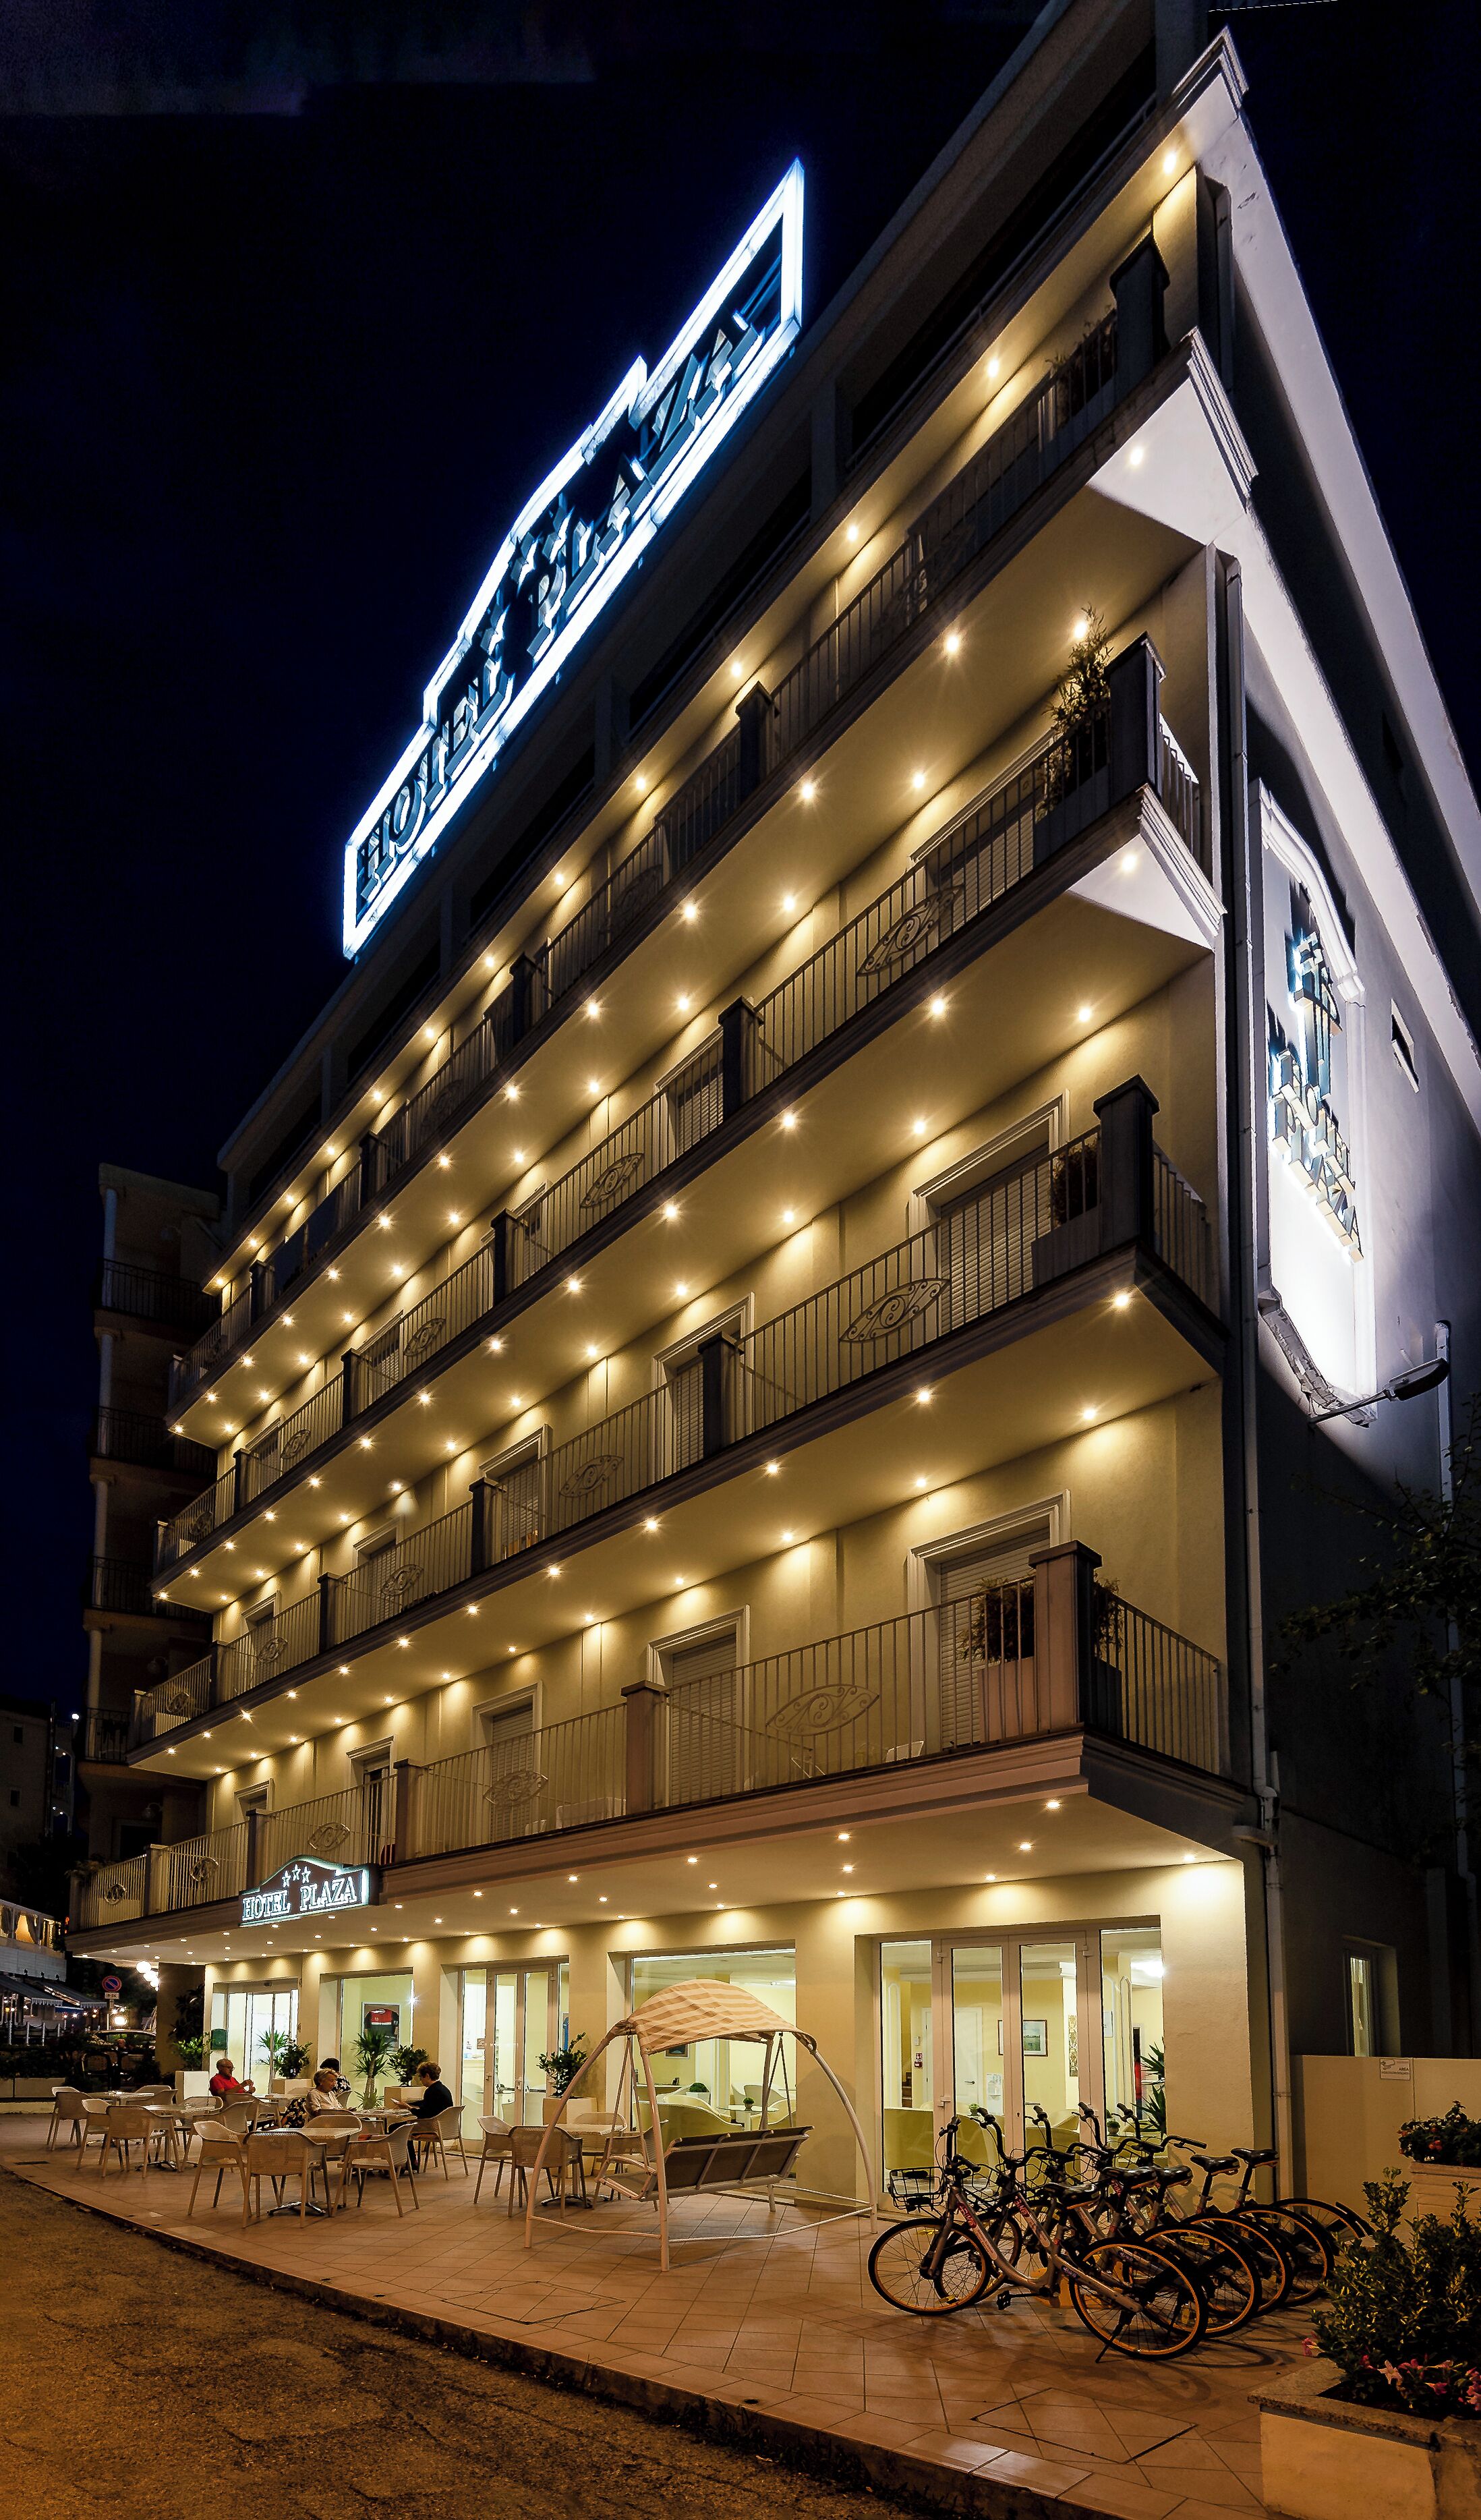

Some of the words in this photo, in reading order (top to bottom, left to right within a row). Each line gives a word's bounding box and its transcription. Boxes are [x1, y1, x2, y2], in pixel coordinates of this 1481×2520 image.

[359, 656, 515, 902] HOTEL
[527, 311, 765, 664] PLAZA
[1272, 1091, 1364, 1263] PLAZA
[241, 1889, 291, 1921] HOTEL
[299, 1876, 357, 1912] PLAZA
